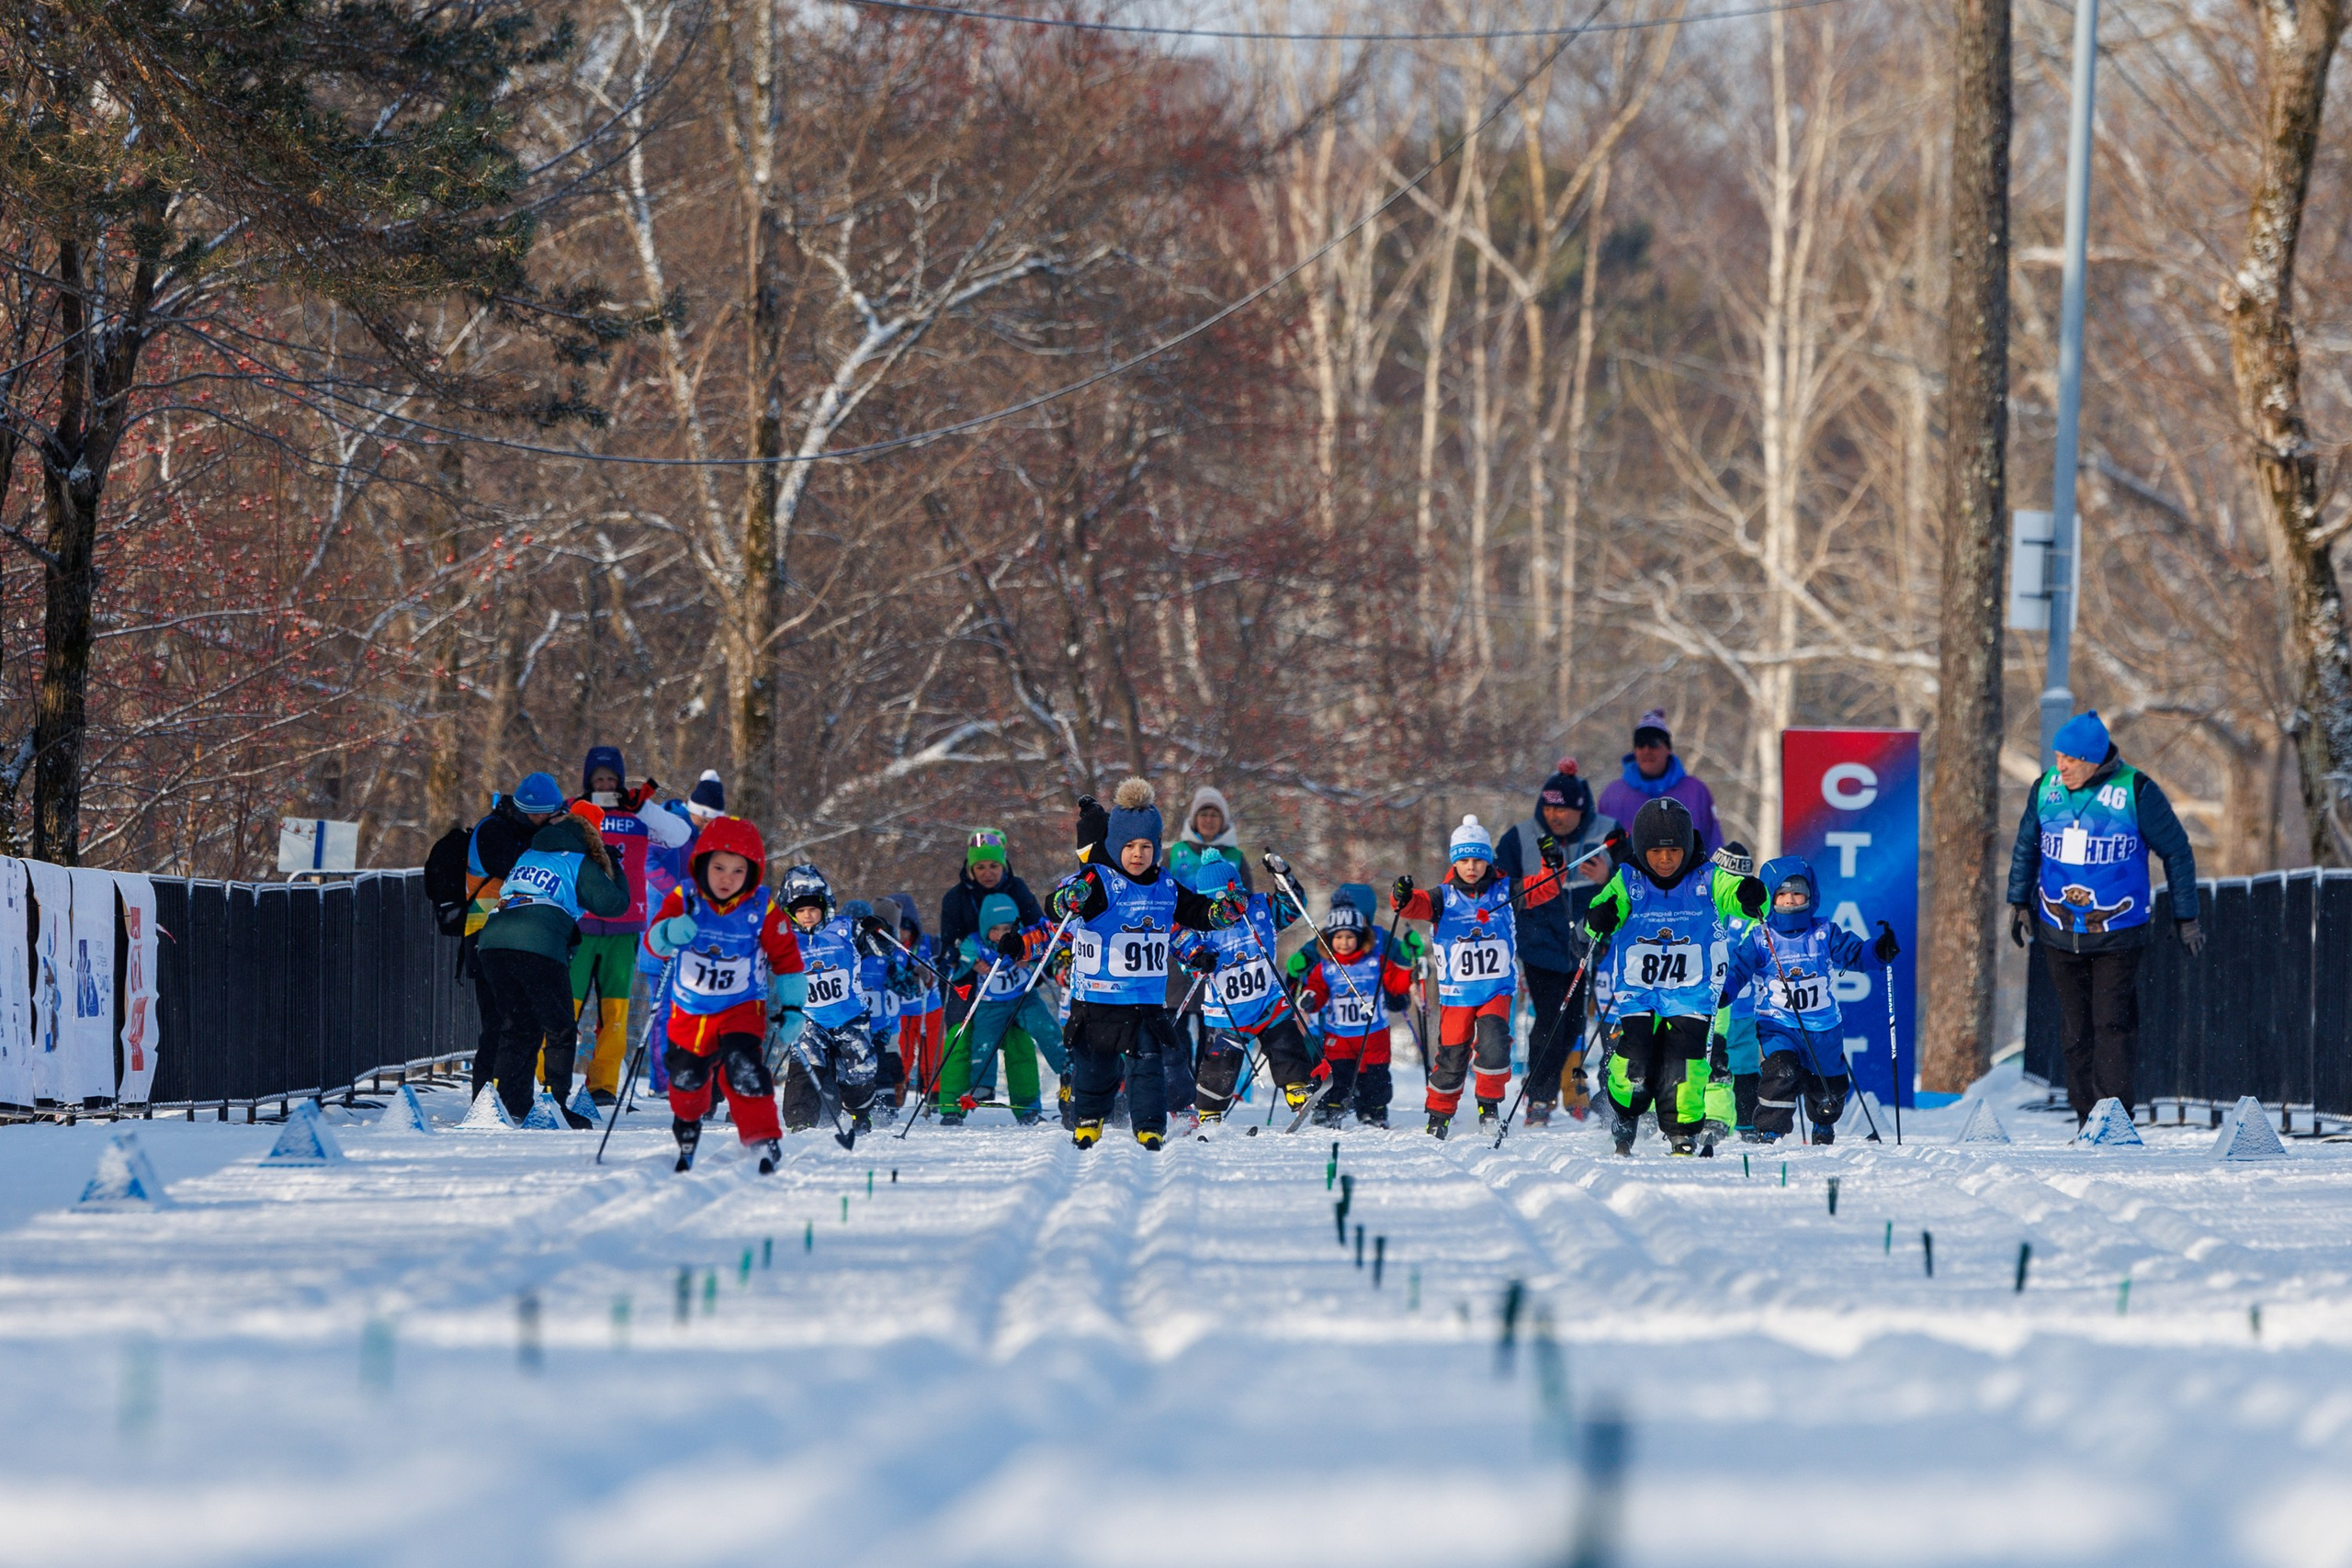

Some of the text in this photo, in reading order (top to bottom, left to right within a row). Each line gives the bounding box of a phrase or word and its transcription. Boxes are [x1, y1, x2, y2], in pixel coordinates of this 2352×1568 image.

[2097, 784, 2128, 810] 46
[1077, 941, 1094, 959] 910
[1125, 942, 1165, 972] 910
[1461, 948, 1499, 976] 912
[695, 962, 736, 991] 713
[1642, 953, 1688, 985] 874
[1226, 967, 1267, 1000] 894
[1781, 985, 1819, 1010] 707
